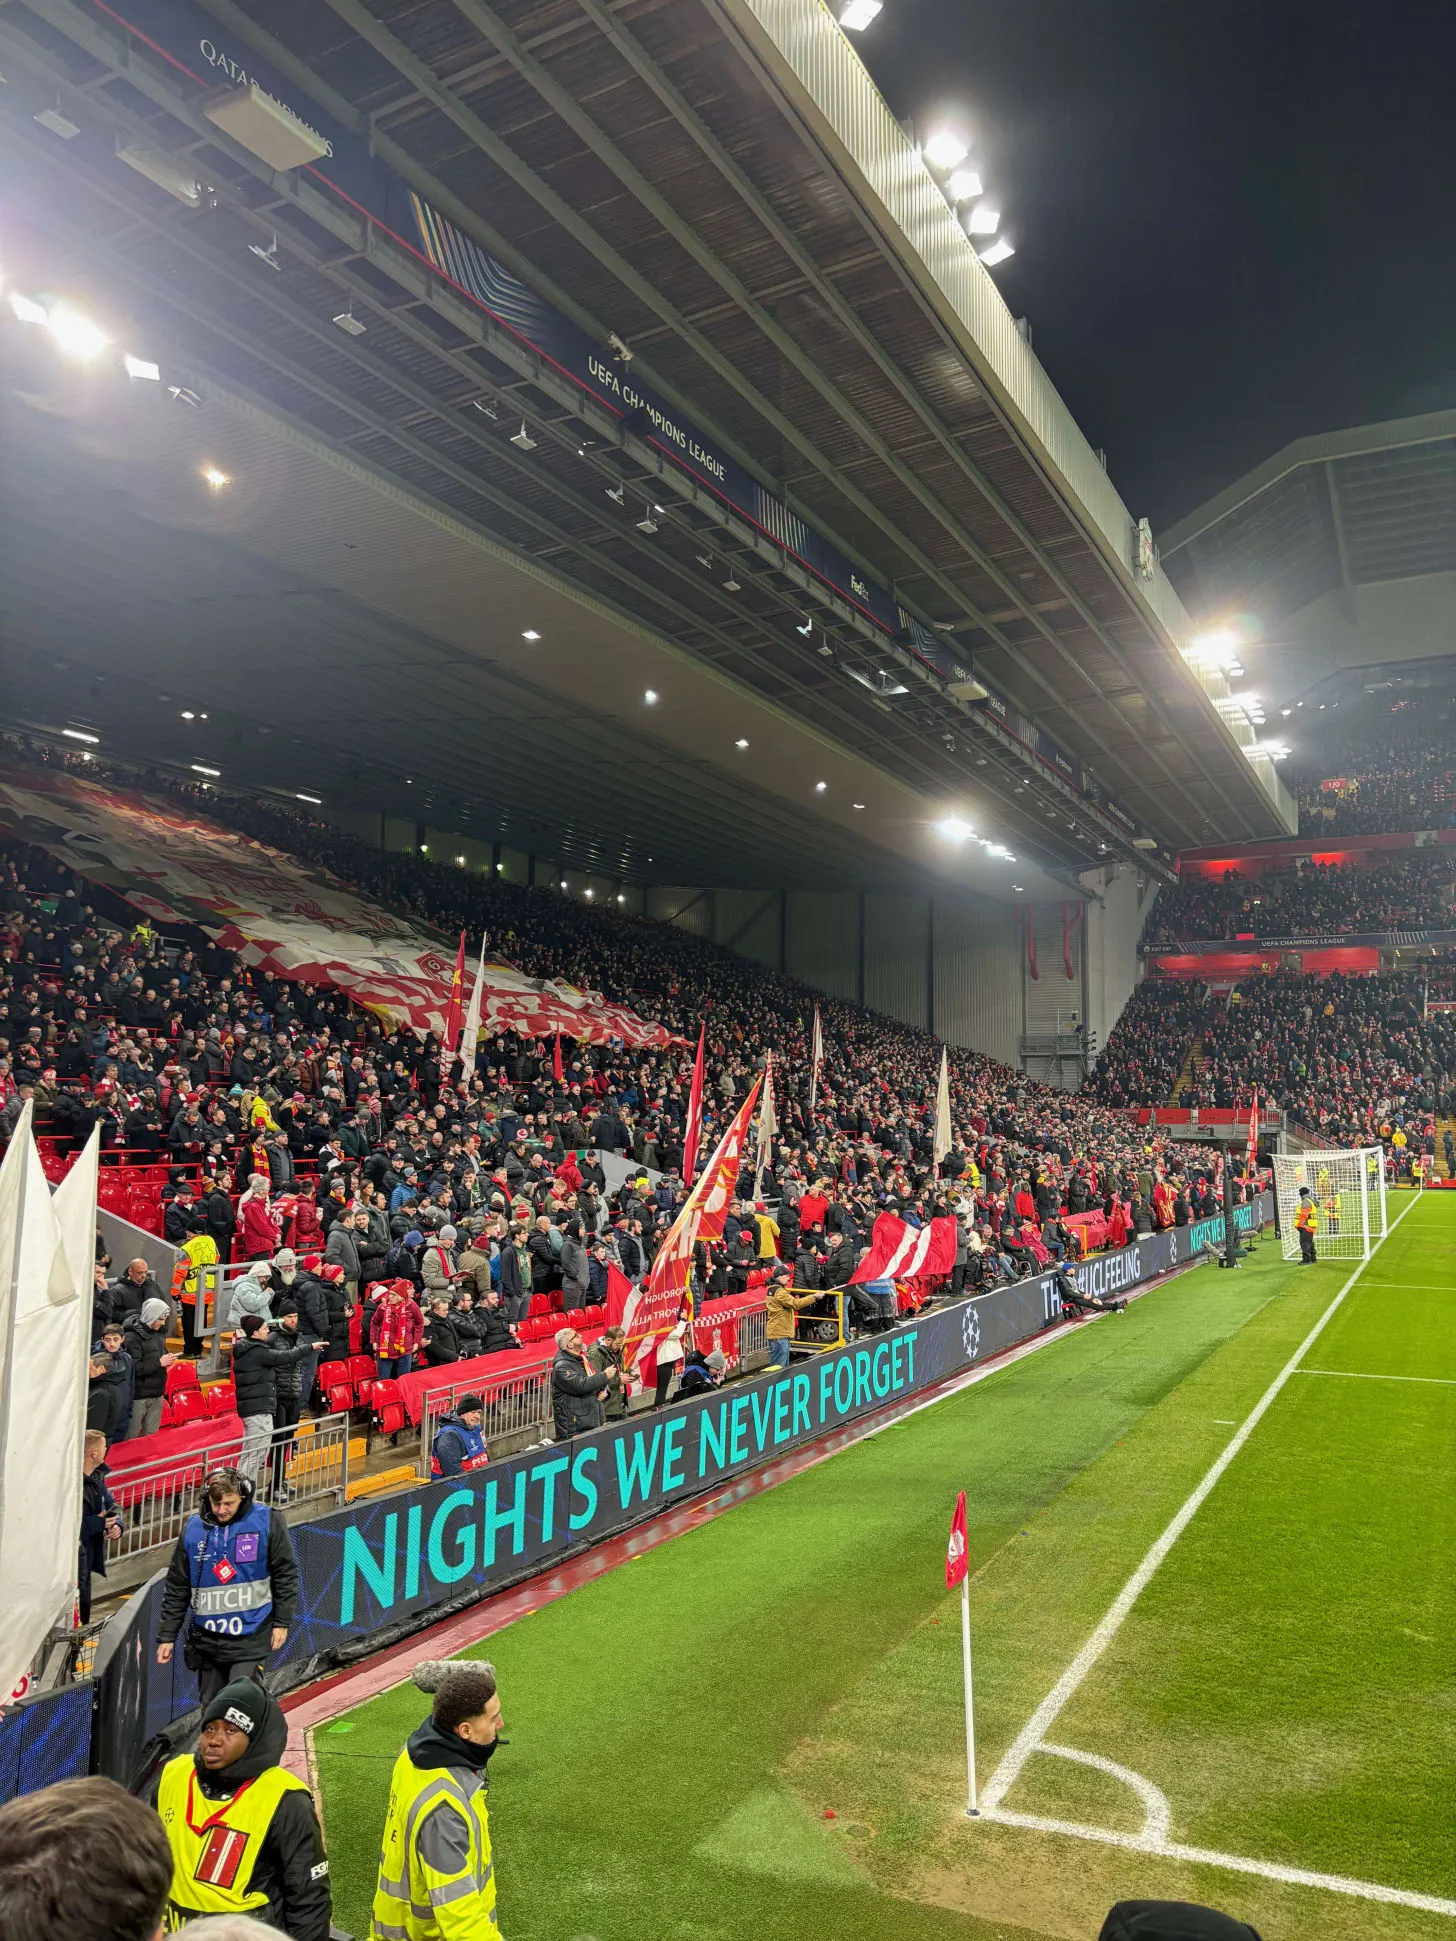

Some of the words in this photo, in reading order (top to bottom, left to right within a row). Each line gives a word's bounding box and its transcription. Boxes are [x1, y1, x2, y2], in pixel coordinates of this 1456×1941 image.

[588, 356, 620, 396] UEFA
[689, 440, 725, 482] LEAGUE
[1078, 1248, 1141, 1297] #UCLFEELING
[340, 1447, 598, 1626] NIGHTS
[615, 1417, 686, 1509] WE
[699, 1374, 811, 1477] NEVER
[820, 1332, 917, 1423] FORGET
[200, 1586, 252, 1611] PITCH
[225, 1706, 254, 1731] FGH
